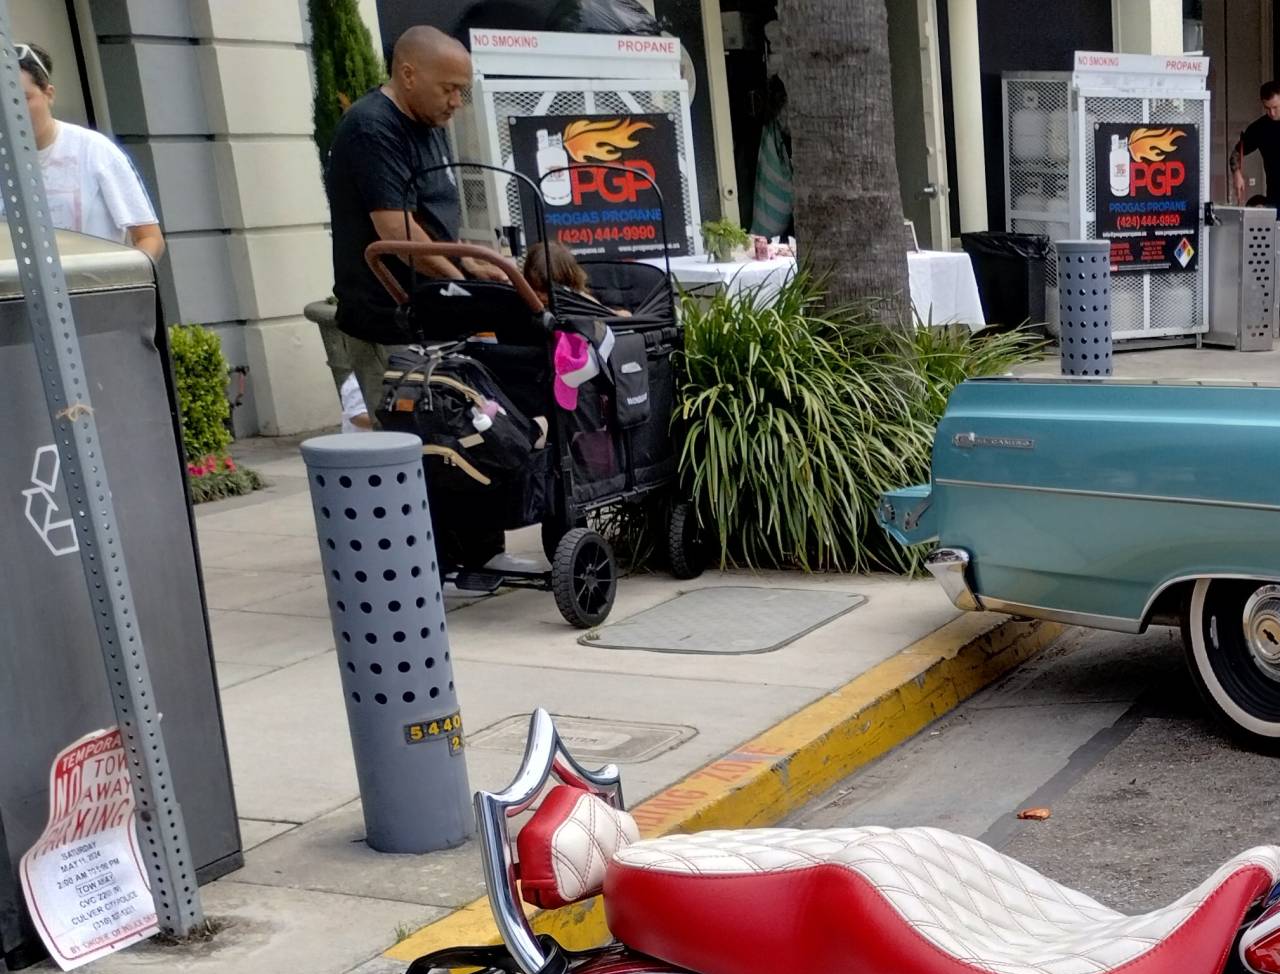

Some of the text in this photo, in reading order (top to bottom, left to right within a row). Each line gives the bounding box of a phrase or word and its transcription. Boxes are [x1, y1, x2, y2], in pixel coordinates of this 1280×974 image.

[473, 35, 538, 48] NO SMOKING
[617, 40, 675, 53] PROPANE
[1078, 57, 1119, 67] NO SMOKING
[1166, 61, 1203, 72] PROPANE
[570, 160, 657, 205] PGP
[1129, 161, 1186, 197] PGP
[1109, 201, 1187, 213] PROGAS PROPANE
[602, 208, 663, 223] PROPANE
[1116, 216, 1140, 230] (424)
[557, 225, 656, 245] (424) 444-9990
[61, 735, 122, 769] TEMPORA
[61, 841, 98, 861] SATURDAY
[60, 862, 79, 873] MAY
